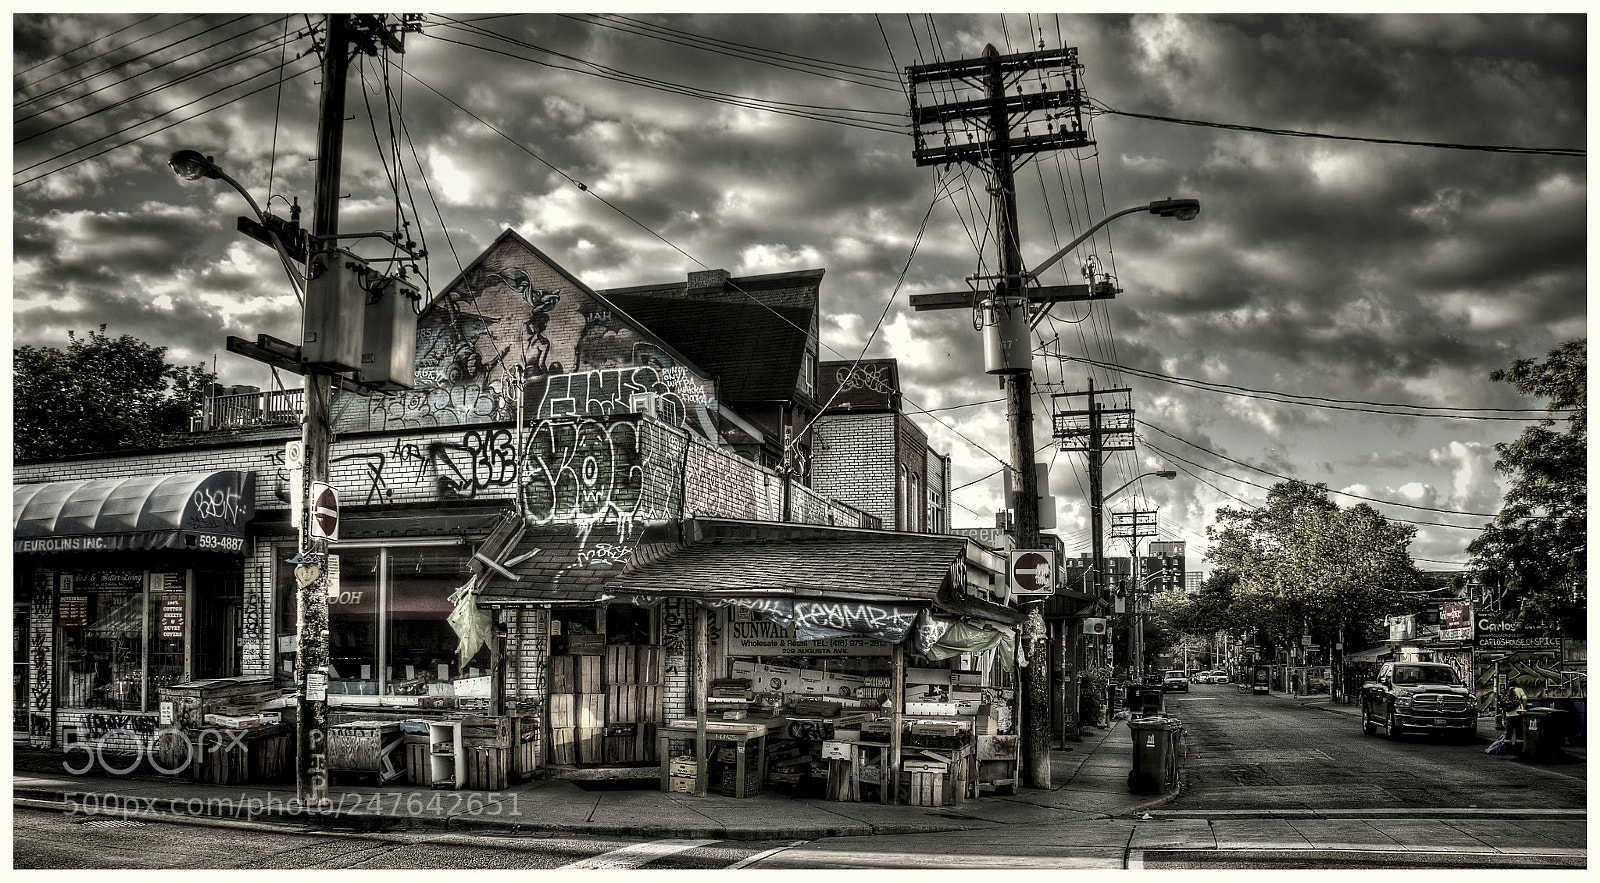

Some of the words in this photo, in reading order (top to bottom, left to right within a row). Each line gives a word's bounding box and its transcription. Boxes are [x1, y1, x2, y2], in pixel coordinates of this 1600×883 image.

[24, 538, 80, 551] EUROLINS
[83, 537, 107, 549] INC.
[199, 535, 244, 551] 593-4887
[733, 621, 789, 638] SUNWAH
[1478, 618, 1517, 632] Carlos
[829, 639, 848, 648] (416)
